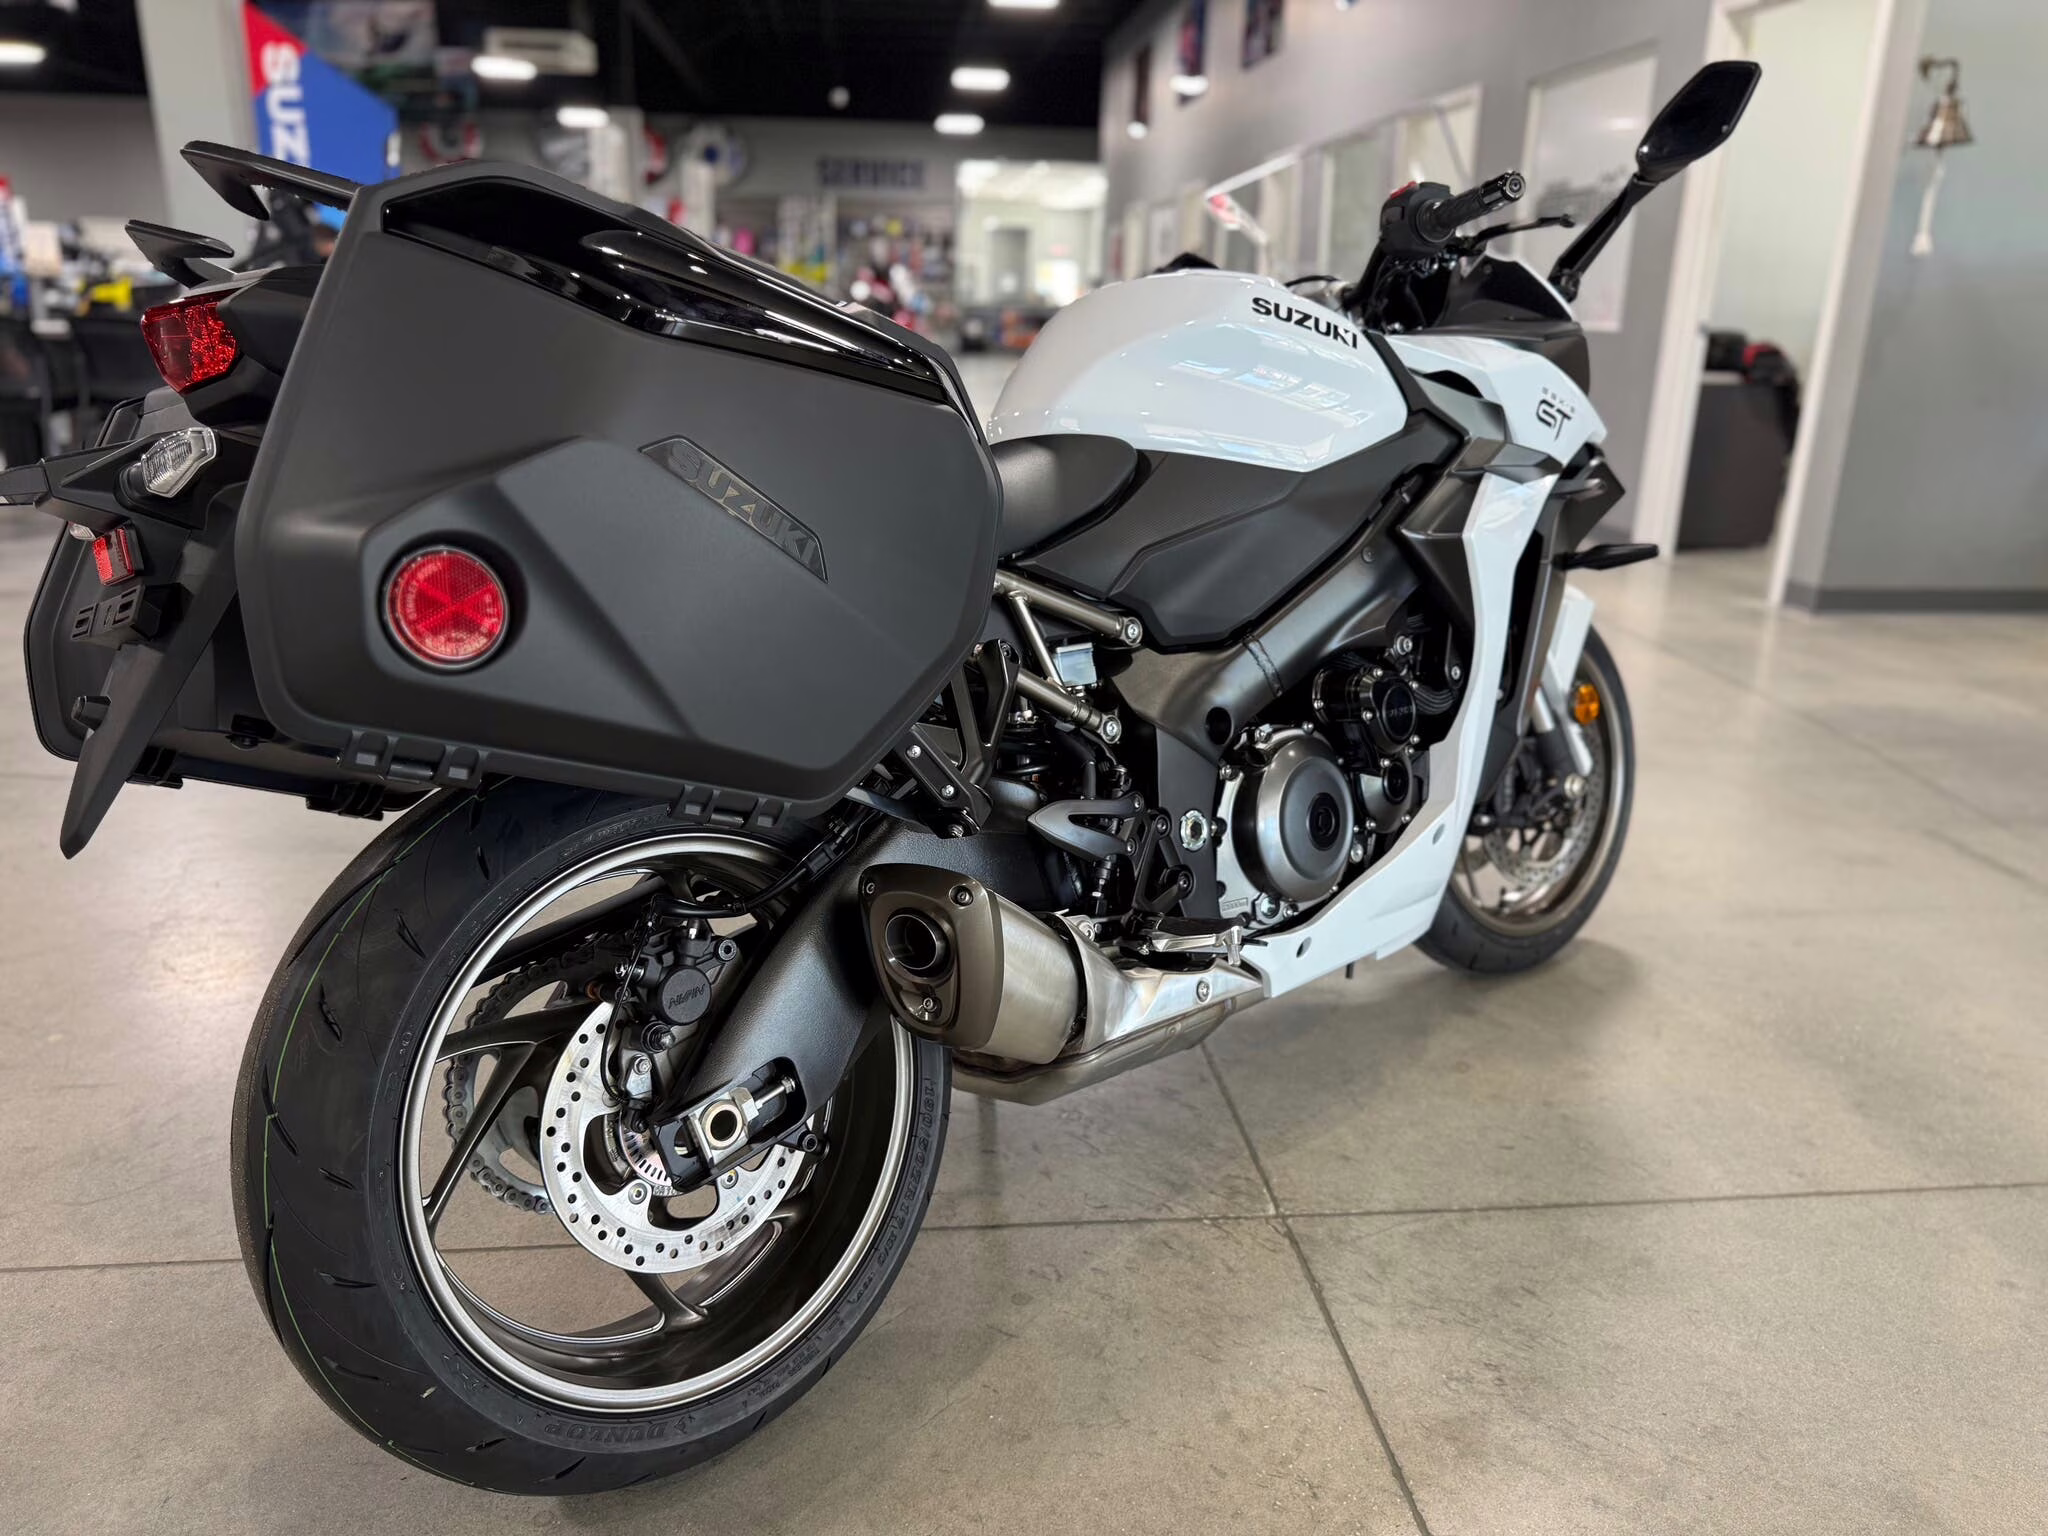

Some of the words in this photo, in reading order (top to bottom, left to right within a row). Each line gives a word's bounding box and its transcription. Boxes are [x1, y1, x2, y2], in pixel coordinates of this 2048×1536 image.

[1251, 297, 1358, 350] SUZUKI
[668, 440, 817, 565] SUZUKI
[544, 1421, 669, 1445] DUNLOP
